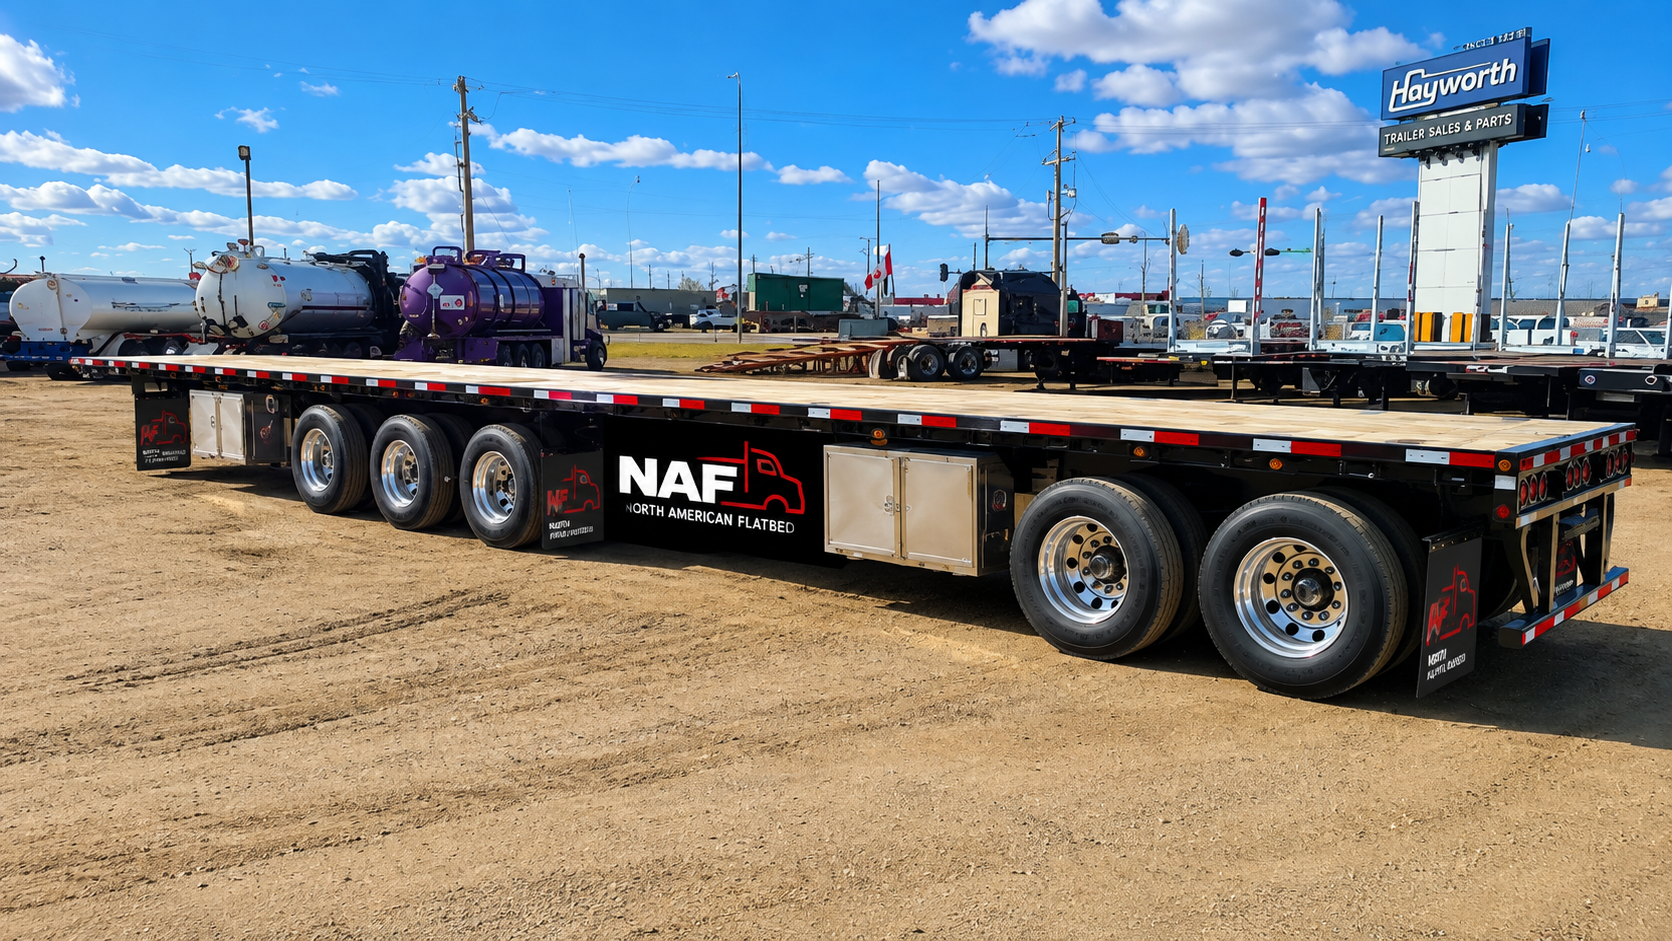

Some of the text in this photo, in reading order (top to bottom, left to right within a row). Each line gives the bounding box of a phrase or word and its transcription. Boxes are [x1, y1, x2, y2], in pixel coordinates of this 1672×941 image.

[1388, 58, 1518, 113] Hayworth
[1384, 113, 1512, 145] TRAILER SALES & PARTS
[619, 455, 738, 504] NAF
[625, 502, 795, 534] NORTH AMERICAN FLATBED
